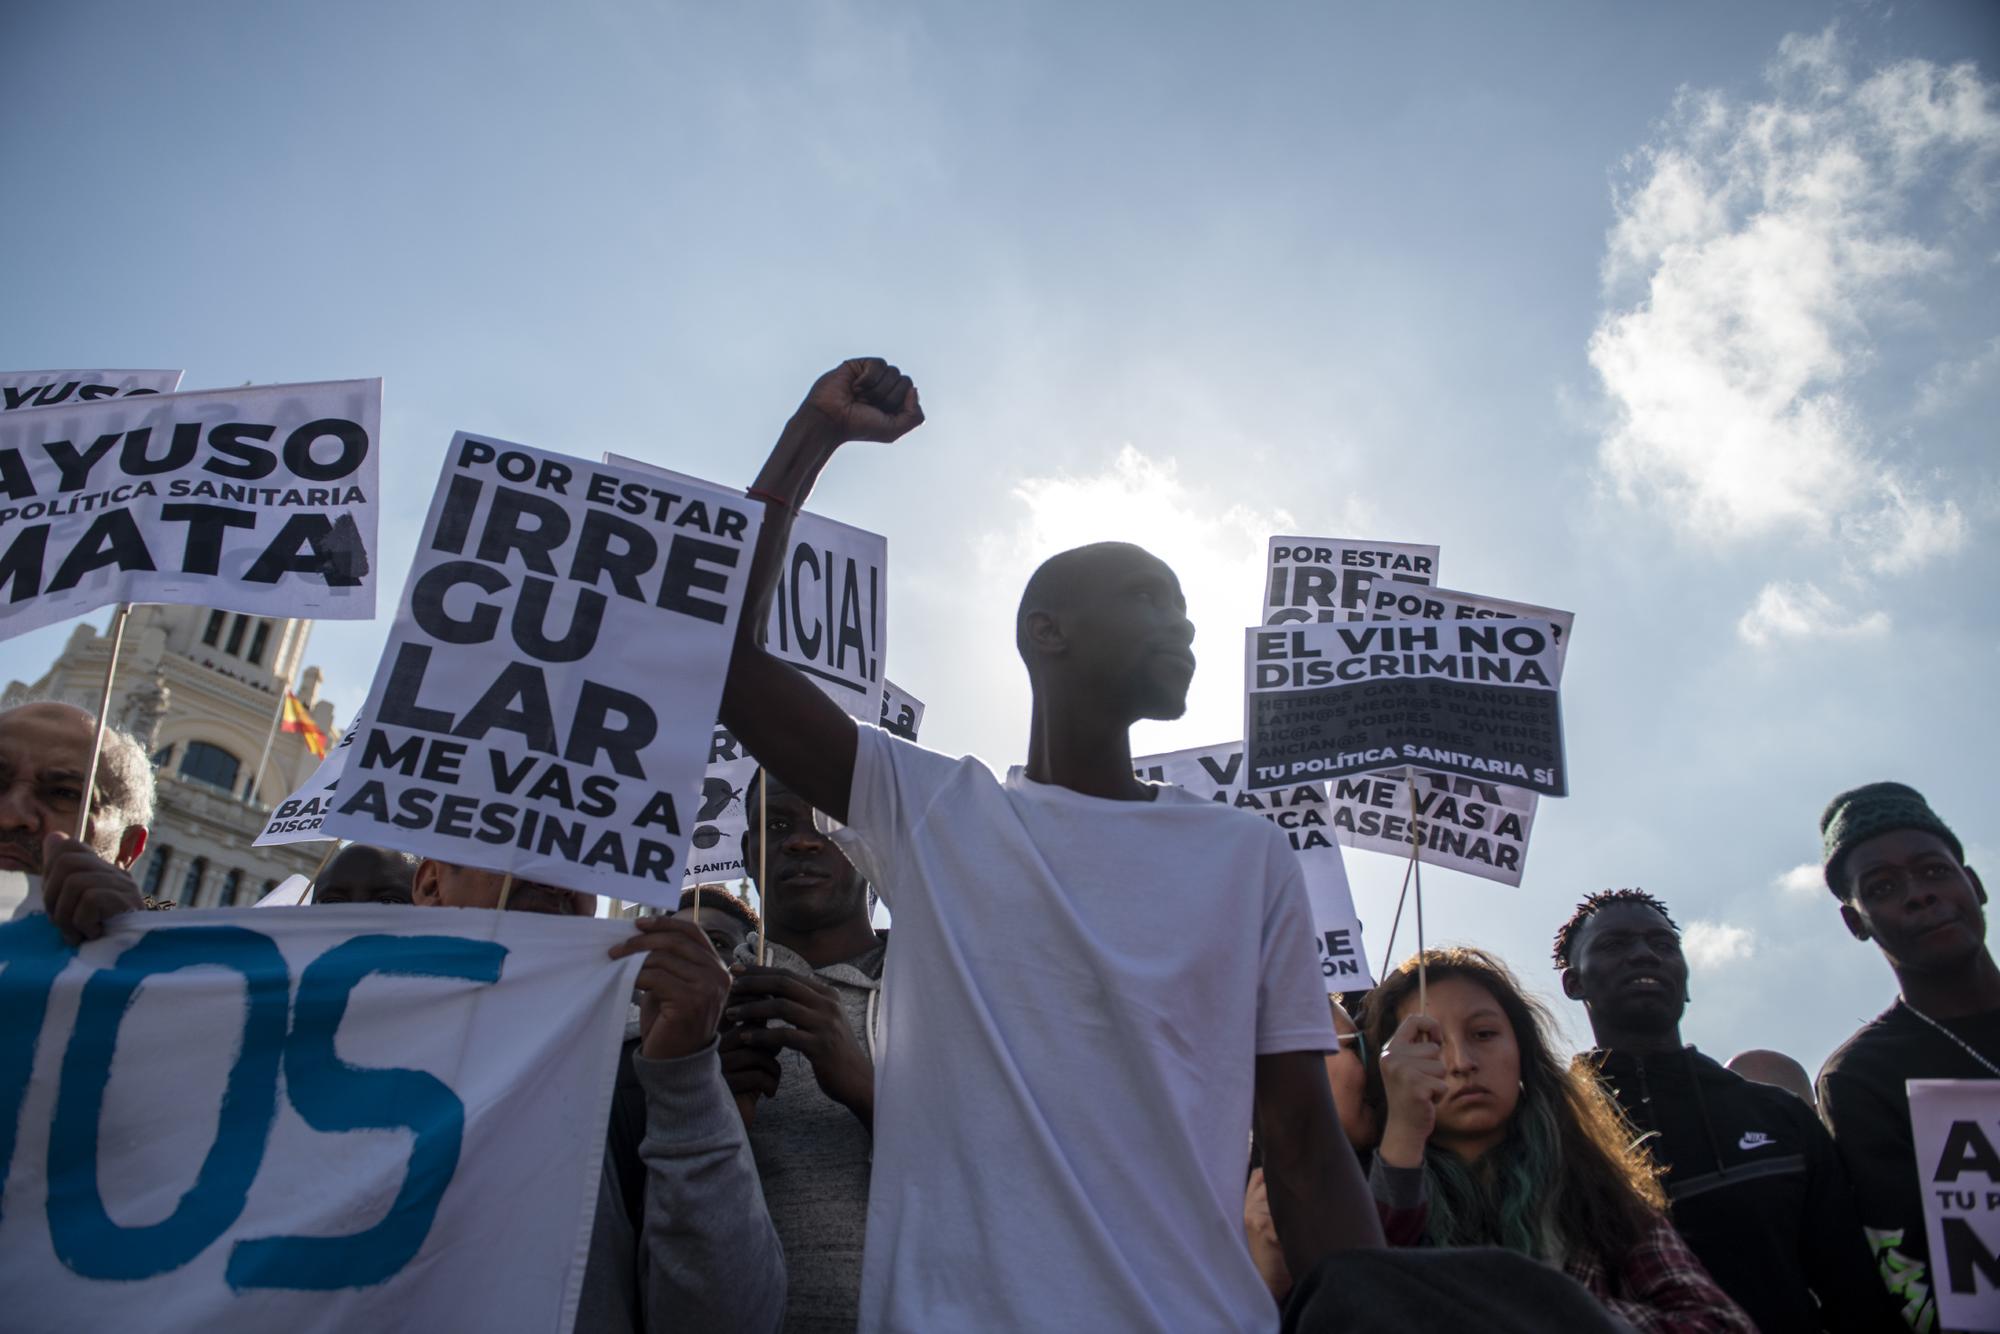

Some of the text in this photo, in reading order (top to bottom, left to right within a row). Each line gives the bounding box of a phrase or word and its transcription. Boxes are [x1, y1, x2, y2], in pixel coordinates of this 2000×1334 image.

[0, 480, 367, 527] POLÍTICA SANITARIA
[457, 439, 749, 542] POR ESTAR
[431, 473, 741, 625] IRRE
[1273, 546, 1432, 574] POR ESTAR
[411, 560, 608, 663] GU
[765, 541, 878, 683] ICIA!
[1375, 591, 1445, 620] POR
[1256, 626, 1546, 661] EL VIH NO
[1256, 654, 1552, 688] DISCRIMINA
[377, 641, 658, 781] LAR
[1364, 683, 1418, 697] GAYS
[1429, 684, 1551, 708] ESPAÑOLES
[1348, 712, 1432, 729] POBRES
[1256, 728, 1554, 762] ANCIAN@S MADRES HIJOS
[1256, 745, 1554, 786] TU POLÍTICA SANITARIA SÍ
[359, 728, 681, 837] ME VAS A
[338, 780, 675, 884] ASESINAR
[1336, 778, 1397, 809] ME
[1413, 788, 1486, 830] VAS
[1494, 812, 1524, 842] A
[1333, 806, 1520, 872] ASESINAR
[1936, 1190, 1976, 1210] TU
